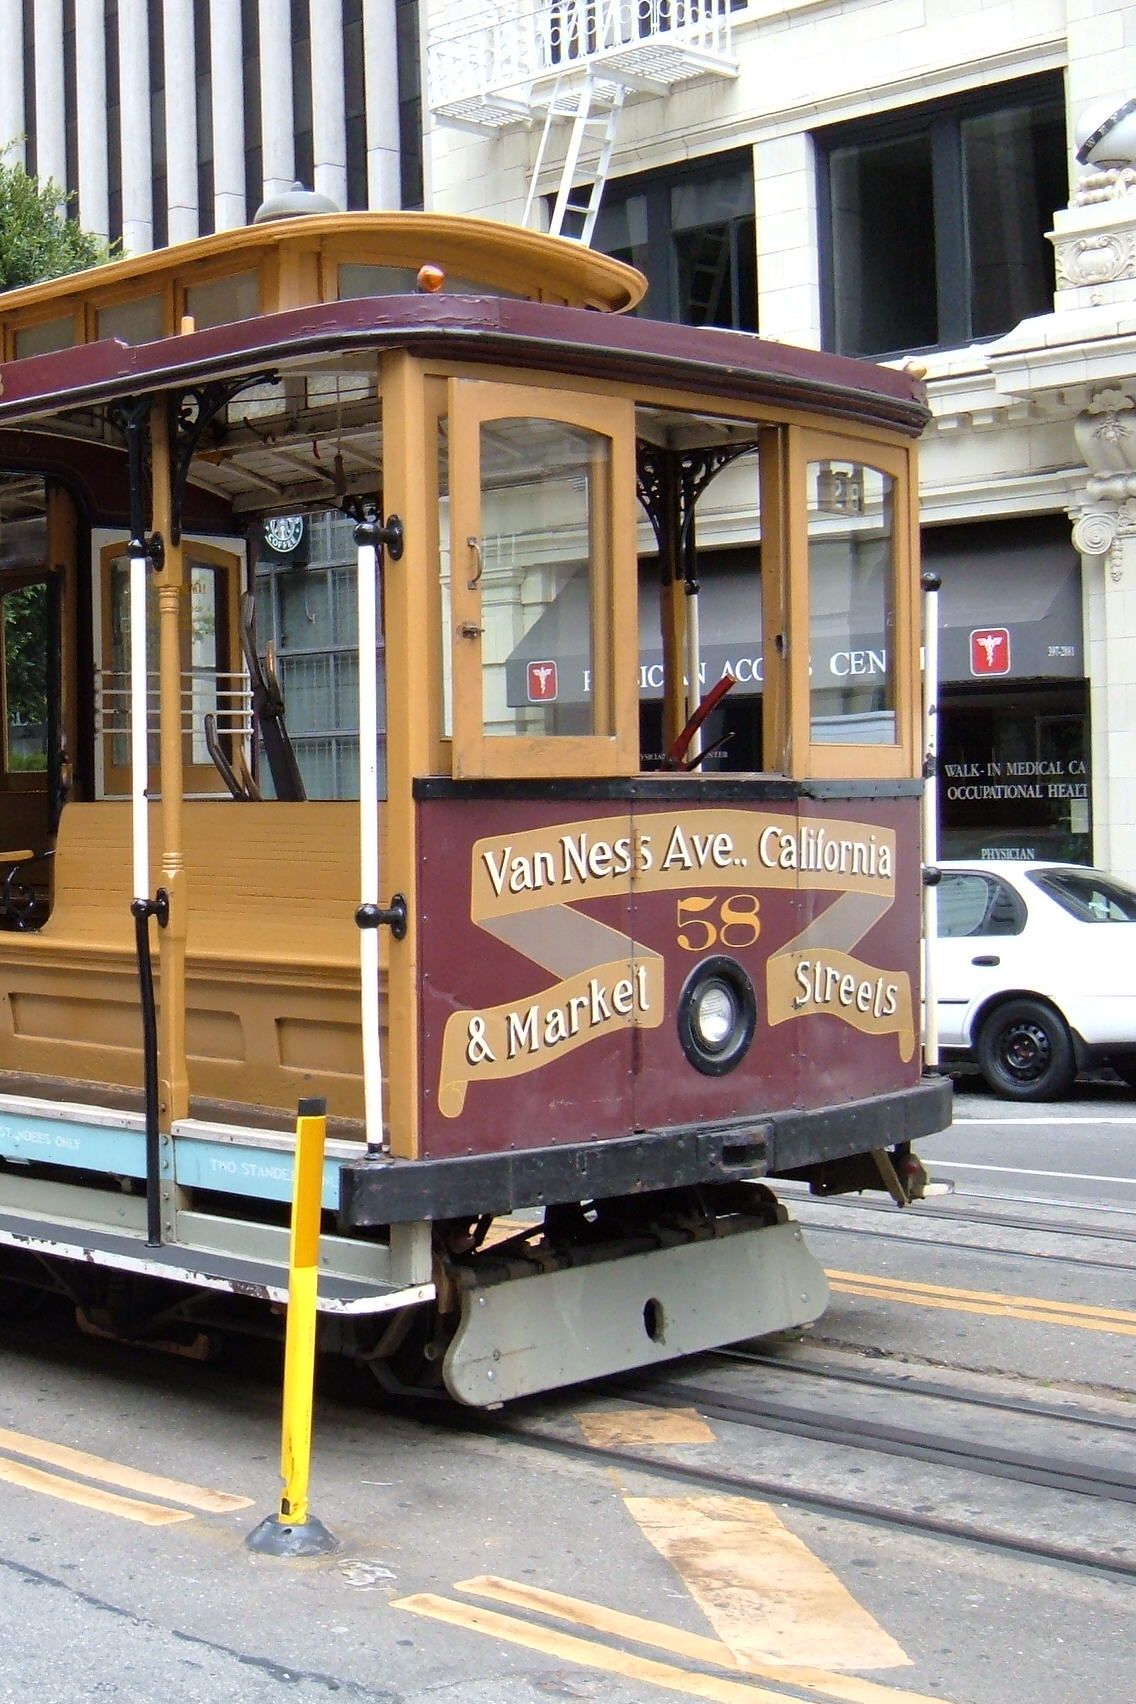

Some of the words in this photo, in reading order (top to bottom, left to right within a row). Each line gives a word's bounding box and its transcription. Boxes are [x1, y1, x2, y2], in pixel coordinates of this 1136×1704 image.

[1006, 761, 1064, 776] MEDICAL
[947, 785, 1043, 800] OCCUPATIONAL
[1048, 783, 1088, 798] HEALT
[482, 847, 555, 897] Van
[560, 832, 653, 882] Ness
[759, 826, 893, 879] California
[981, 848, 1035, 860] PHYSICIAN
[677, 894, 761, 951] 58
[792, 960, 898, 1019] Streets
[467, 1015, 497, 1065] &
[505, 964, 651, 1060] Market
[210, 1158, 237, 1173] TWO
